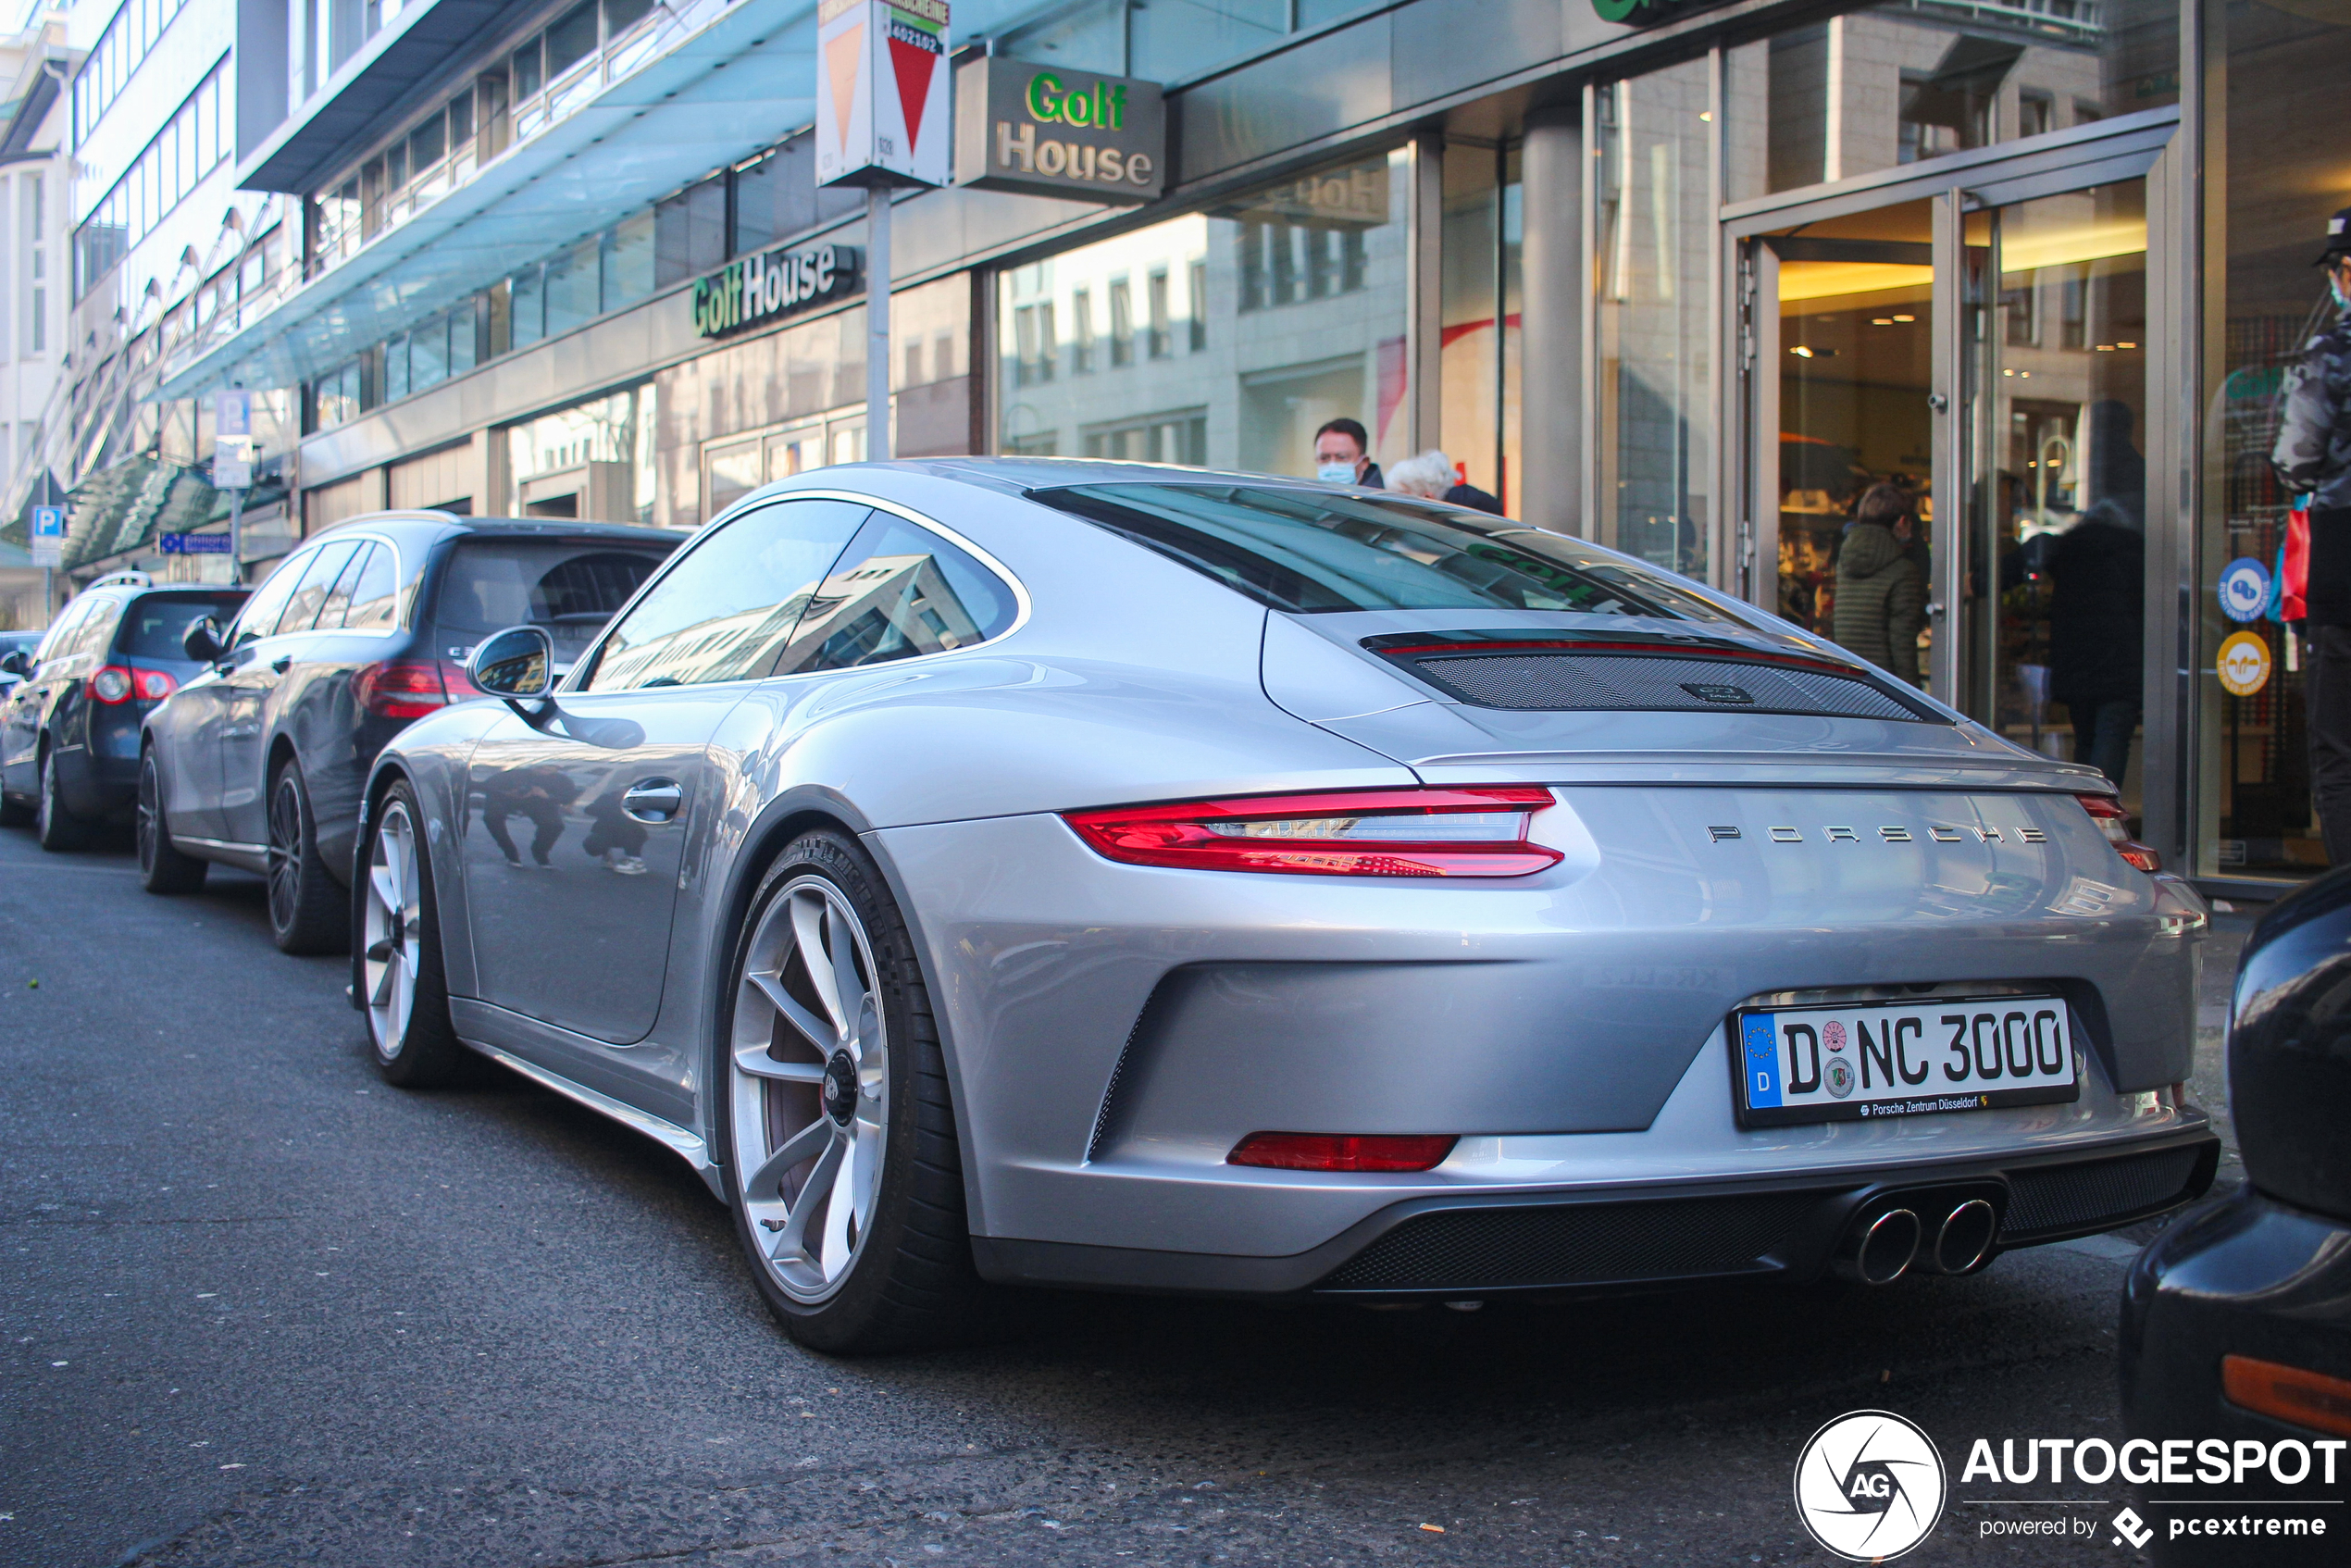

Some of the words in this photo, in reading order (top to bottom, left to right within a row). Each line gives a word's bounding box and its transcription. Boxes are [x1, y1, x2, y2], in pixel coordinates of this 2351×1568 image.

[1027, 72, 1126, 131] Golf
[997, 120, 1153, 185] House
[2226, 367, 2280, 400] Golf
[40, 511, 56, 535] P
[1705, 826, 2047, 843] PORSCHE
[834, 852, 886, 939] MICHELIN
[1783, 1024, 1822, 1095] D
[1856, 1016, 1929, 1089] NC
[1940, 1010, 2064, 1082] 3000
[1757, 1071, 1770, 1093] D
[1872, 1102, 1904, 1115] Porsche
[1907, 1099, 1936, 1113] Zentrum
[1939, 1096, 1978, 1110] Düsseldorf
